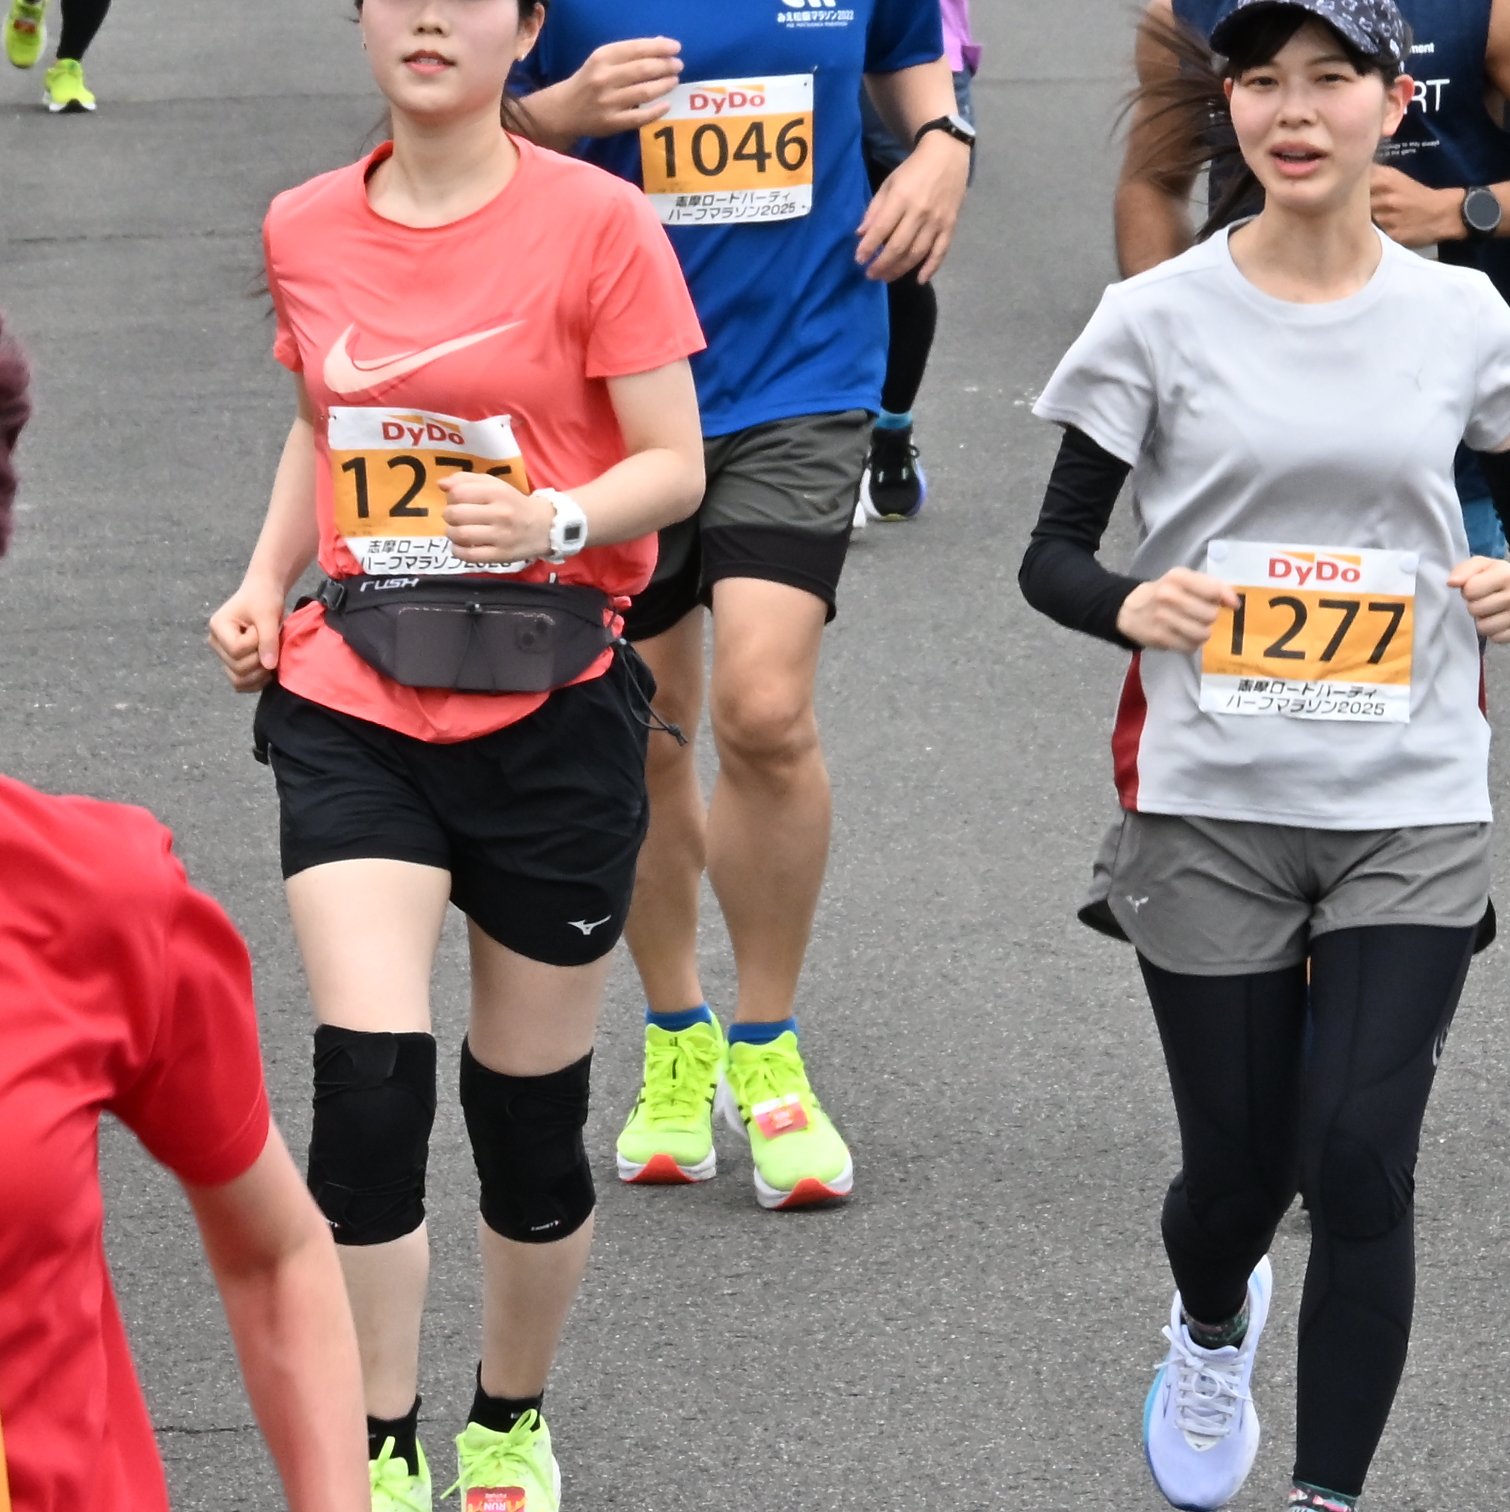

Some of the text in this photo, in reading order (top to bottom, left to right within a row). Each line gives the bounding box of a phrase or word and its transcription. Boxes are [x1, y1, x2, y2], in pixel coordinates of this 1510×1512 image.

[689, 91, 766, 114] DyDo
[1403, 78, 1451, 115] RT
[653, 118, 808, 179] 1046
[668, 202, 796, 221] ハーフマラソン2025
[381, 421, 465, 446] DyDo
[342, 455, 512, 519] 12
[1268, 558, 1361, 586] DyDo
[1231, 593, 1406, 665] 1277
[1226, 694, 1386, 715] ハーフマラソン2025
